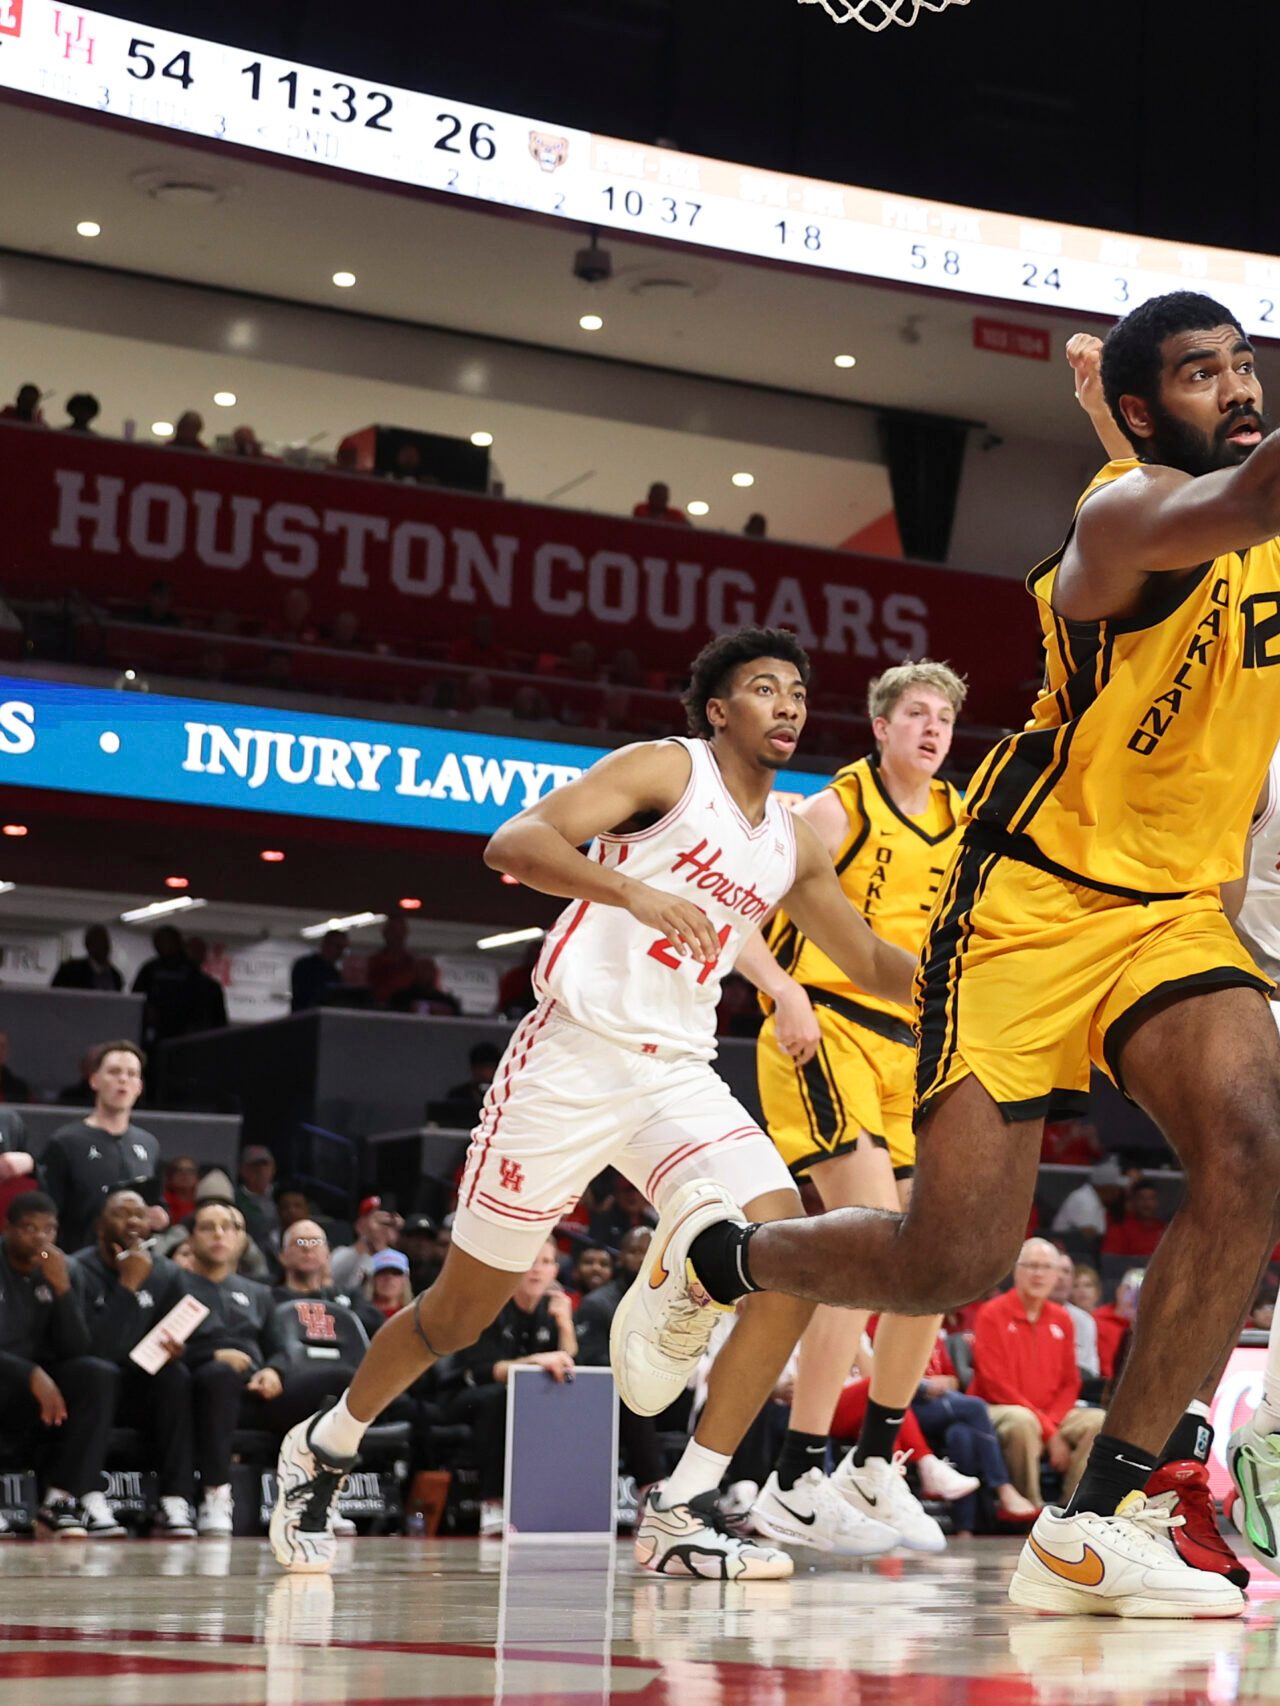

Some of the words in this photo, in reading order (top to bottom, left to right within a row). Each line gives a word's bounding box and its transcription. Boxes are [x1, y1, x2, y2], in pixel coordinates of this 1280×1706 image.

[125, 38, 195, 91] 54
[240, 61, 394, 133] 11:32
[433, 112, 497, 162] 26
[1021, 263, 1062, 290] 24
[1113, 277, 1129, 302] 3
[1259, 299, 1275, 323] 2
[51, 469, 519, 610] HOUSTON
[533, 543, 929, 661] COUGARS
[1126, 577, 1229, 756] OAKLAND
[182, 721, 391, 793] INJURY
[671, 838, 769, 924] Houston
[864, 846, 893, 930] OAKL
[500, 1155, 525, 1193] UH
